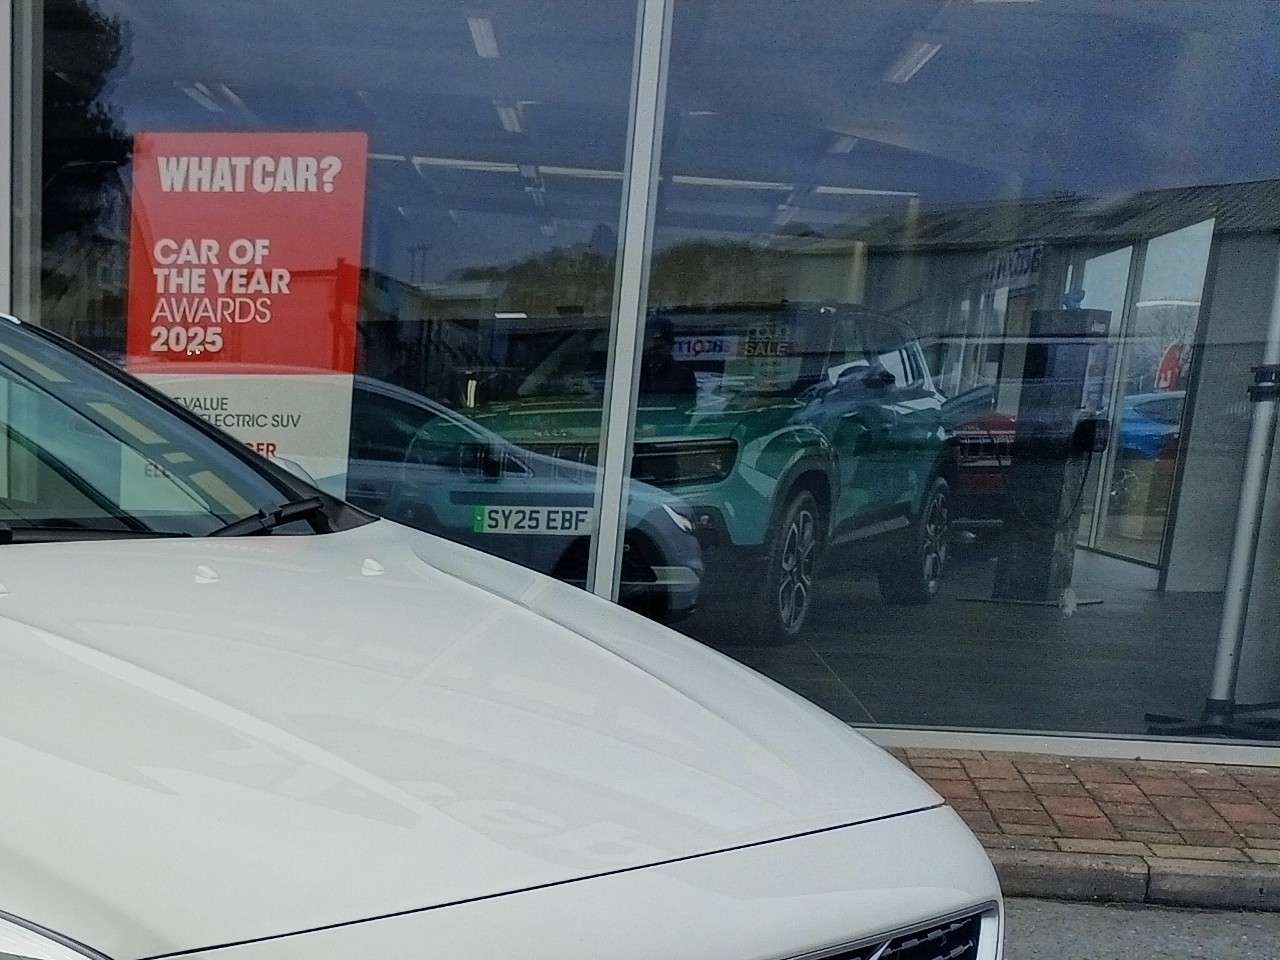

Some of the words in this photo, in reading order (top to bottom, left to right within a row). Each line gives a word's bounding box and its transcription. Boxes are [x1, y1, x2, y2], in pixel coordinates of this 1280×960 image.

[157, 156, 251, 192] WHAT
[252, 156, 342, 192] CAR?
[153, 238, 220, 265] CAR
[228, 238, 270, 265] OF
[153, 267, 206, 294] THE
[213, 267, 291, 294] YEAR
[150, 297, 272, 324] AWARDS
[150, 325, 224, 352] 2025
[182, 397, 229, 411] VALUE
[271, 414, 302, 427] SUV
[487, 509, 540, 530] SY25
[546, 510, 588, 530] EBF
